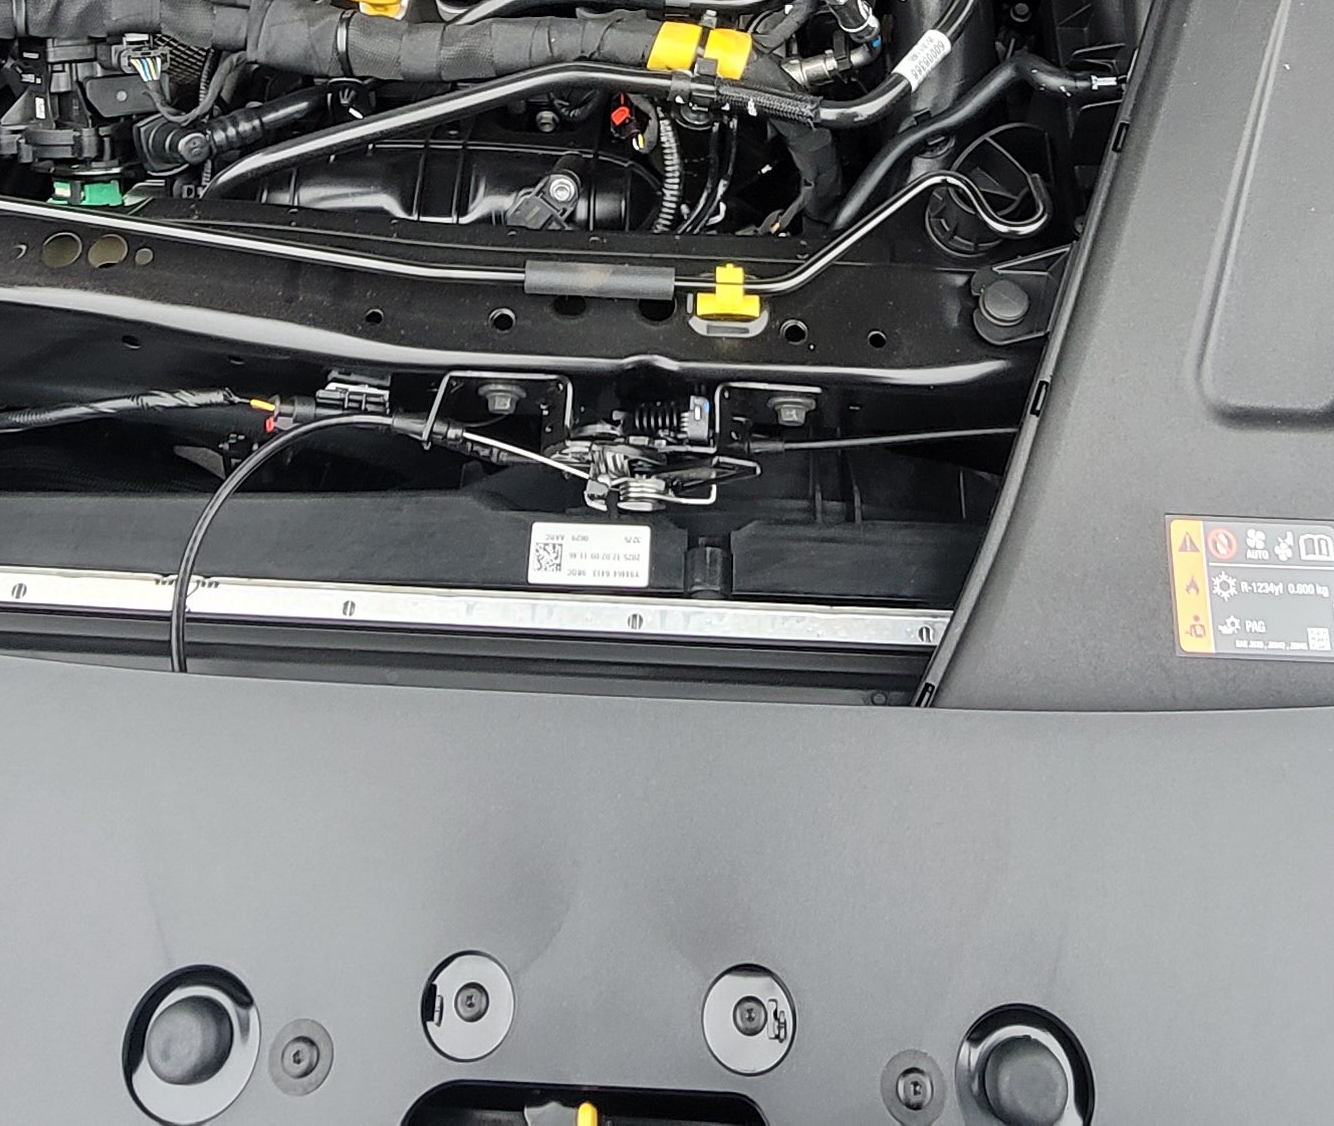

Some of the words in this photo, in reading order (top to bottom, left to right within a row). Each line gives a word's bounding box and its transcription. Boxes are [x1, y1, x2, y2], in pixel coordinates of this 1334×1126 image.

[1246, 549, 1269, 560] AUTO
[1315, 584, 1330, 598] kg
[1245, 620, 1266, 633] PAG
